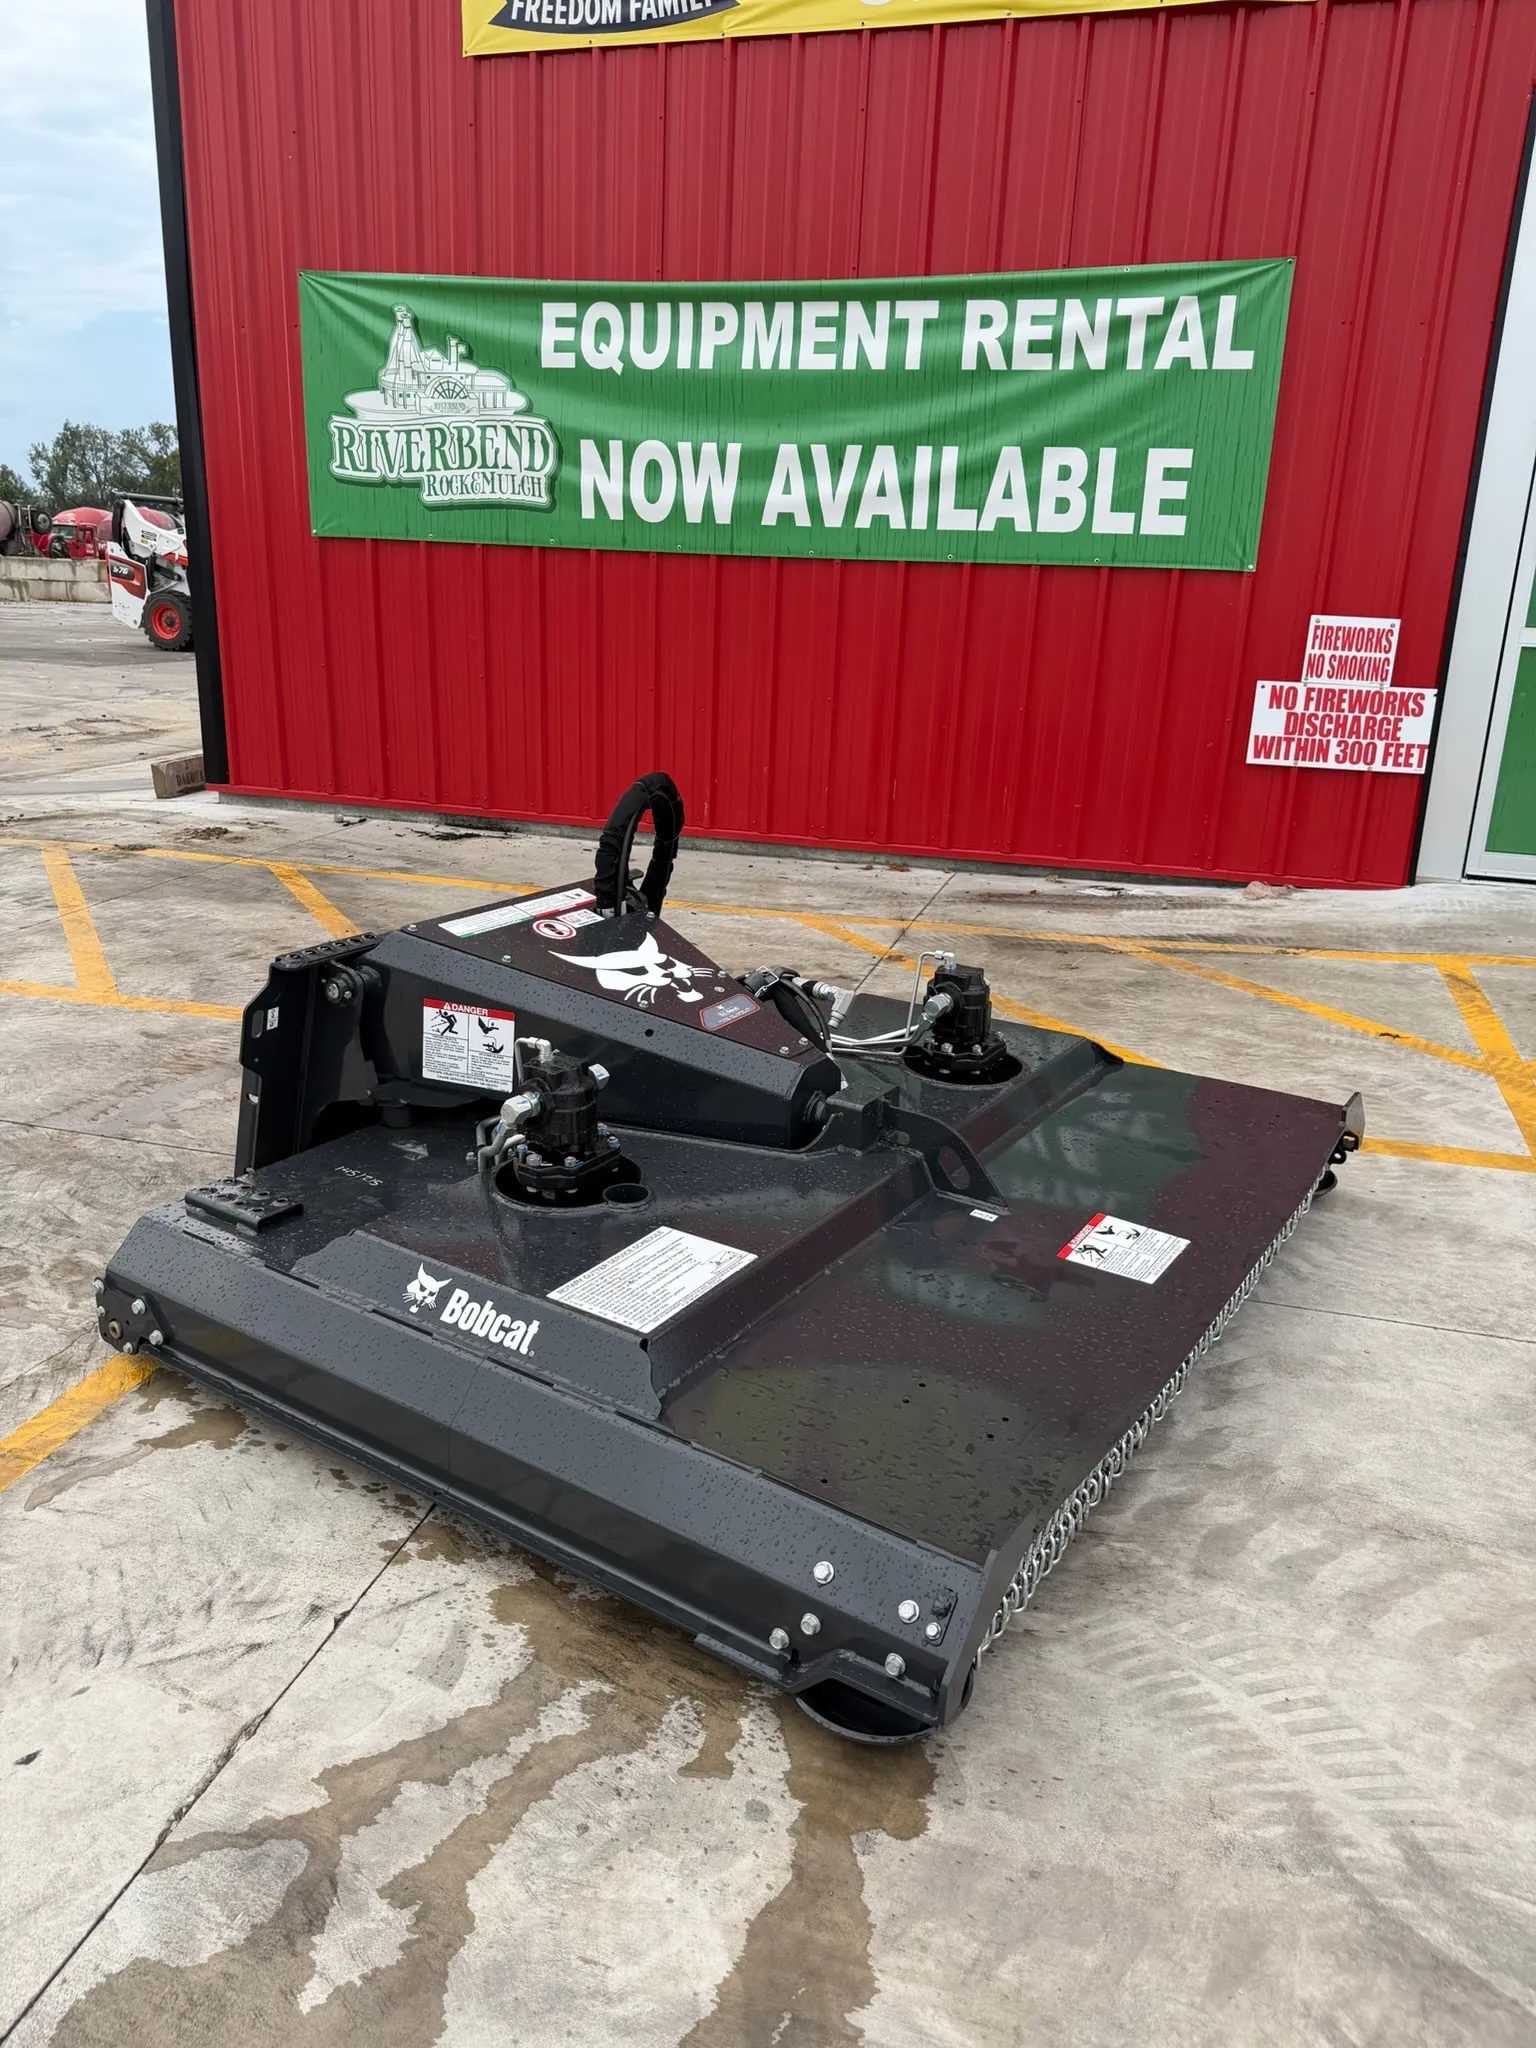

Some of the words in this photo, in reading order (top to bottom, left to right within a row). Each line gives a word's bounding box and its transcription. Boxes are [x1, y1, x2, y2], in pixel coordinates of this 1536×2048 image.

[510, 0, 621, 26] FREEDOM
[629, 0, 712, 22] FAMIL
[540, 299, 939, 375] EQUIPMENT
[961, 295, 1255, 370] RENTAL
[333, 425, 551, 473] RIVERBEND
[580, 439, 742, 525] NOW
[761, 443, 1194, 536] AVAILABLE
[1311, 624, 1394, 655] FIREWORKS
[1305, 652, 1325, 679] NO
[1327, 653, 1391, 683] SMOKING
[1268, 684, 1298, 711] NO
[1303, 686, 1426, 718] FIREWORKS
[1283, 711, 1403, 742] DISCHARGE
[1252, 734, 1331, 763] WITHIN
[1334, 739, 1378, 766] 300
[1381, 742, 1429, 769] FEET
[452, 1003, 488, 1016] DANGER
[1071, 1224, 1095, 1246] DANGER
[439, 1287, 541, 1356] Bobcat
